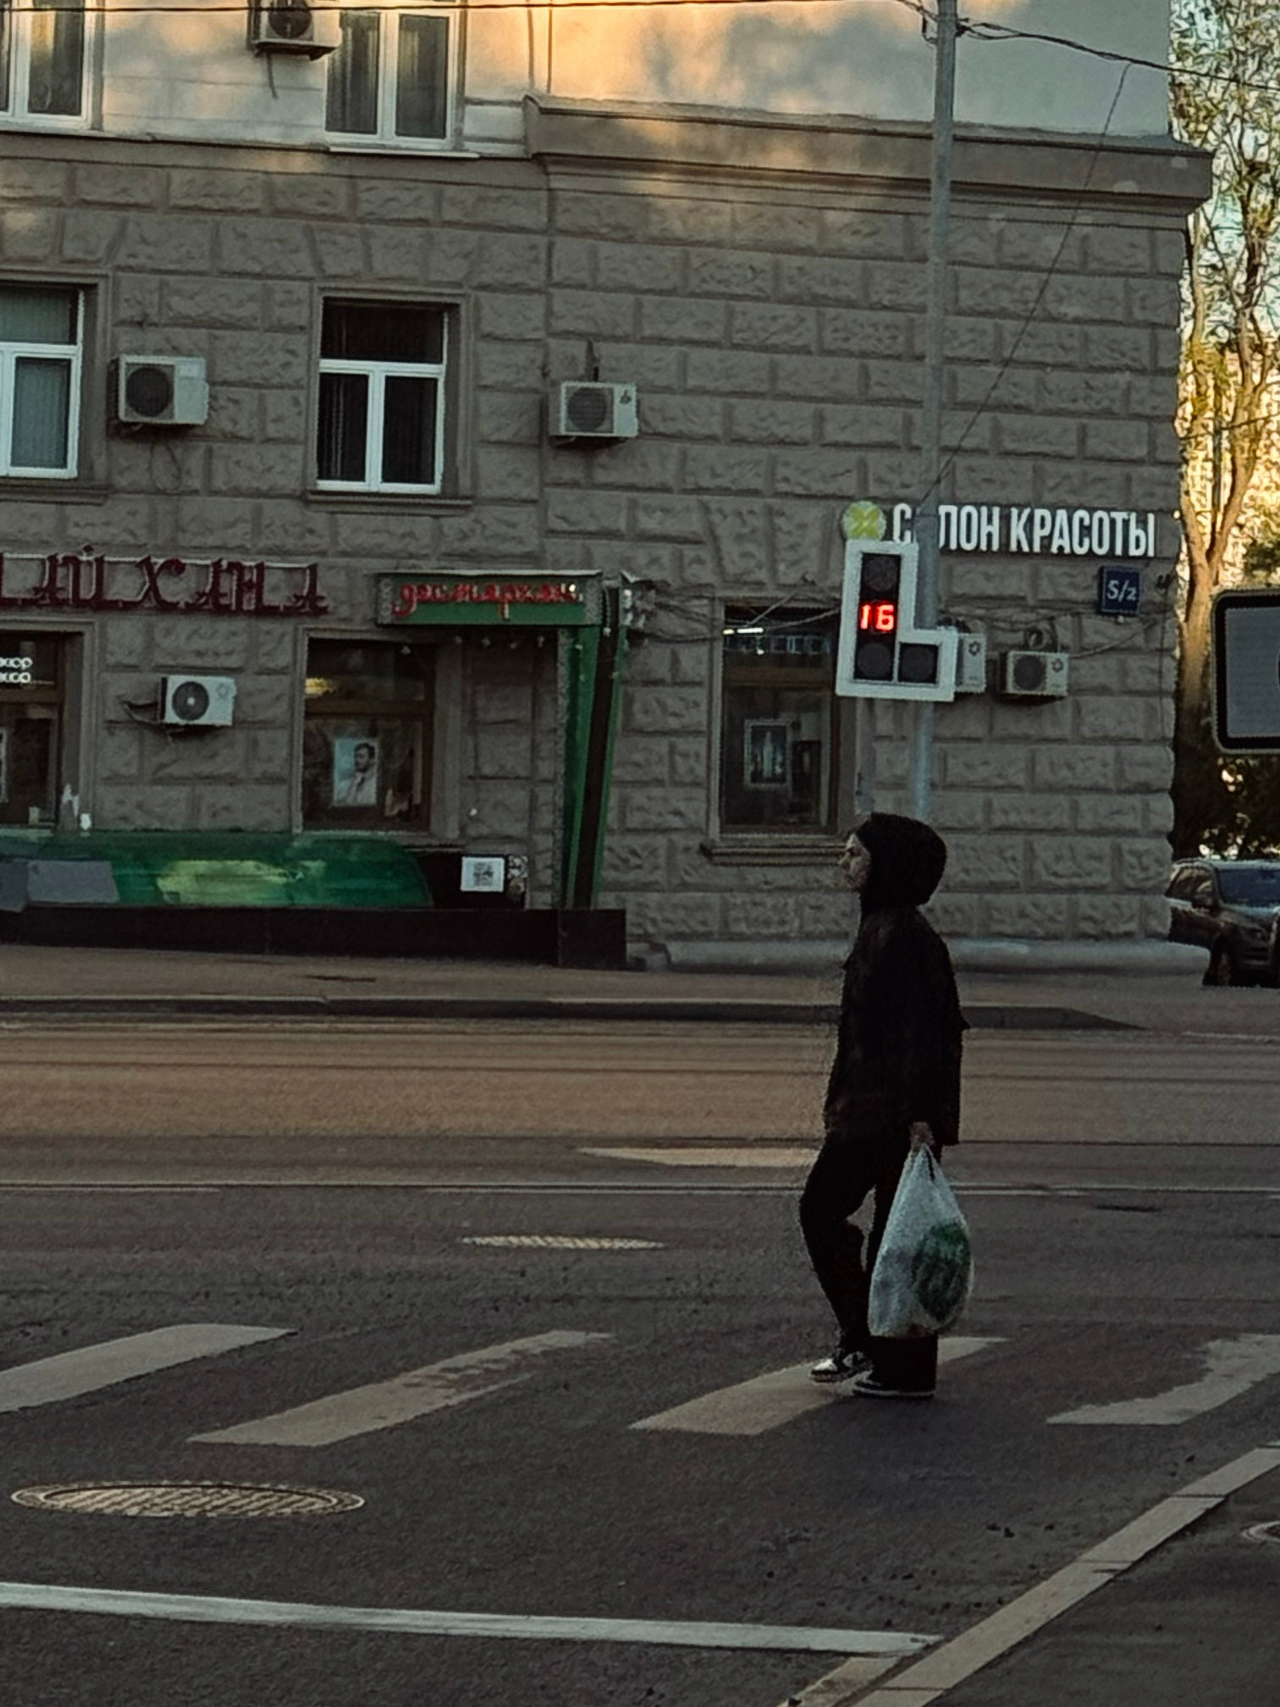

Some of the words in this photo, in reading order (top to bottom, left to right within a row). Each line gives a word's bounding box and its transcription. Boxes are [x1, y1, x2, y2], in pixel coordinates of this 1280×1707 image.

[892, 502, 1001, 552] СЛОН
[1009, 506, 1156, 558] КРАСОТЫ
[860, 603, 895, 632] 16
